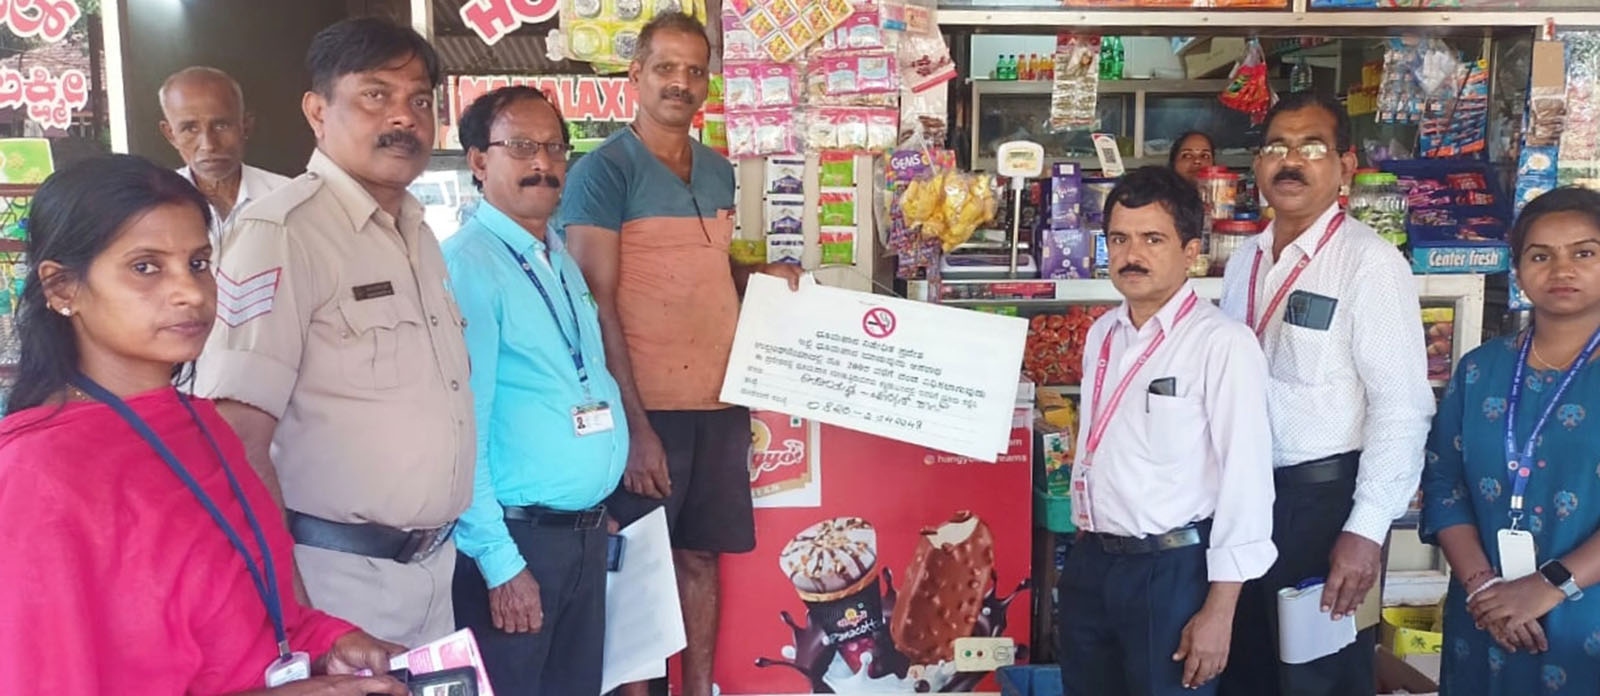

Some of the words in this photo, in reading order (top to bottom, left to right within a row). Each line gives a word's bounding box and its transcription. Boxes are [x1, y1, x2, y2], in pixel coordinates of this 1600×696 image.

[891, 153, 921, 170] GEMS
[1429, 251, 1465, 267] Center
[1469, 250, 1498, 266] fresh
